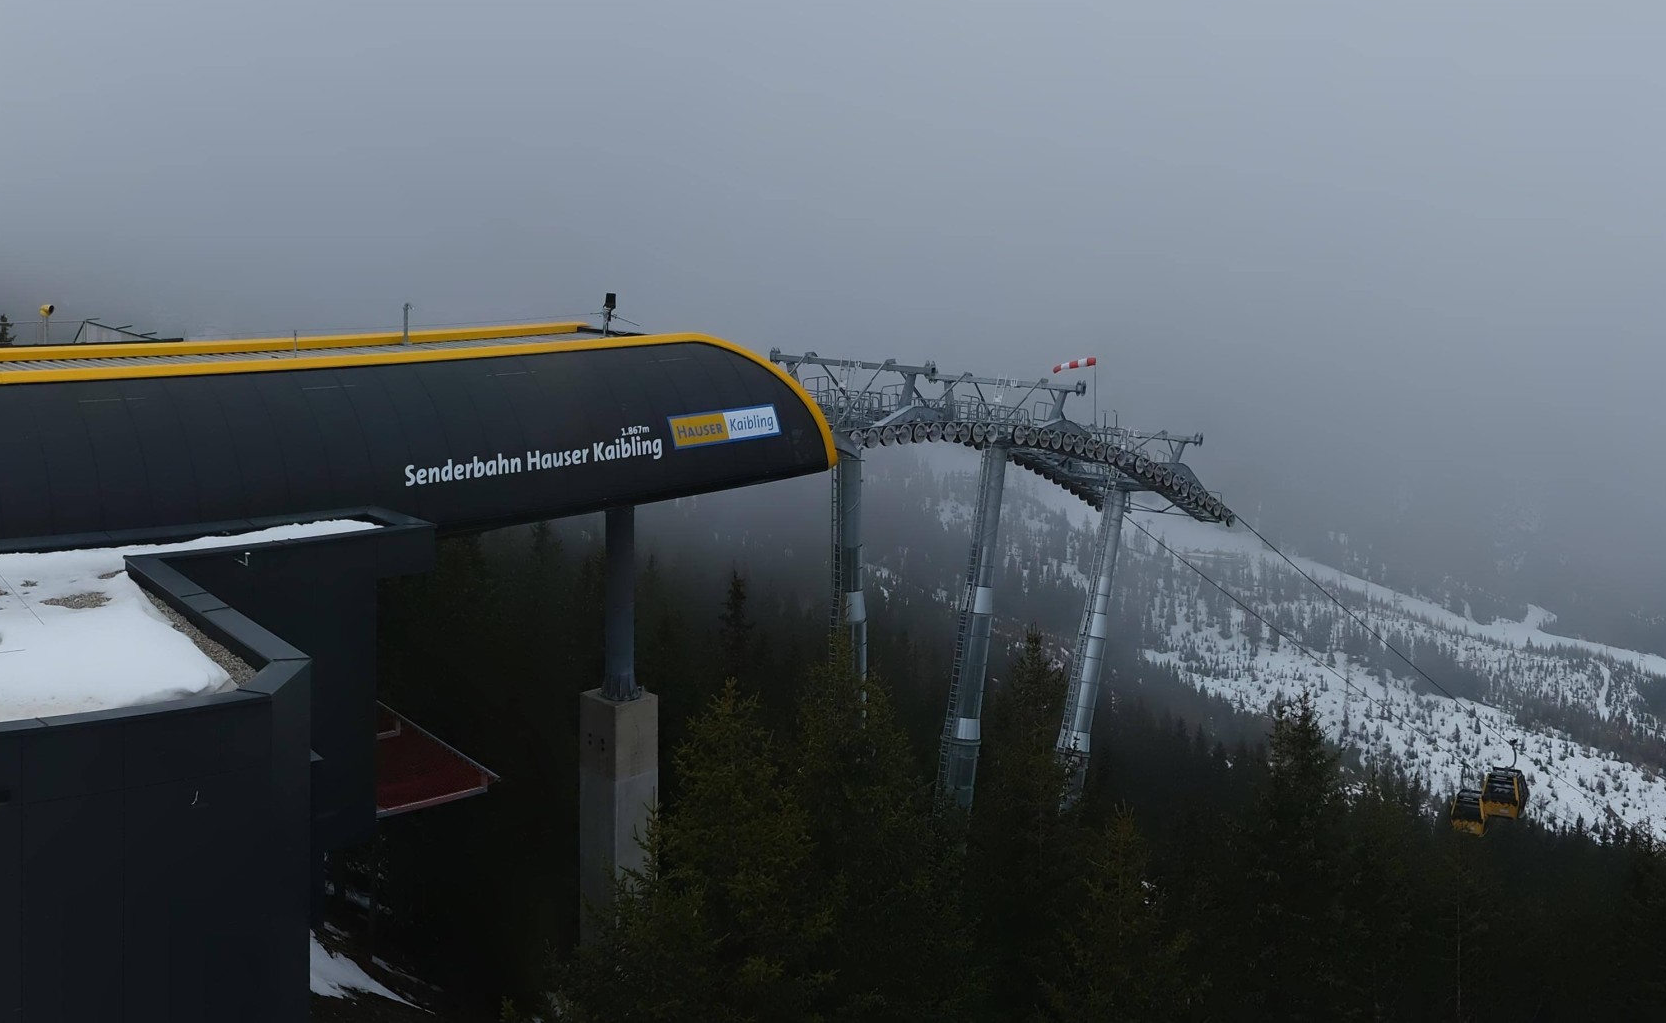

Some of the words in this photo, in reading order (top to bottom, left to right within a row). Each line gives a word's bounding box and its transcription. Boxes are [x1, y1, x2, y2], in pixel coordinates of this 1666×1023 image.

[621, 425, 650, 437] 1.867m
[676, 423, 724, 439] HAUSER
[730, 415, 774, 431] Kaibling
[404, 453, 522, 487] Senderbahn
[527, 448, 589, 471] Hauser
[593, 435, 663, 463] Kaibling
